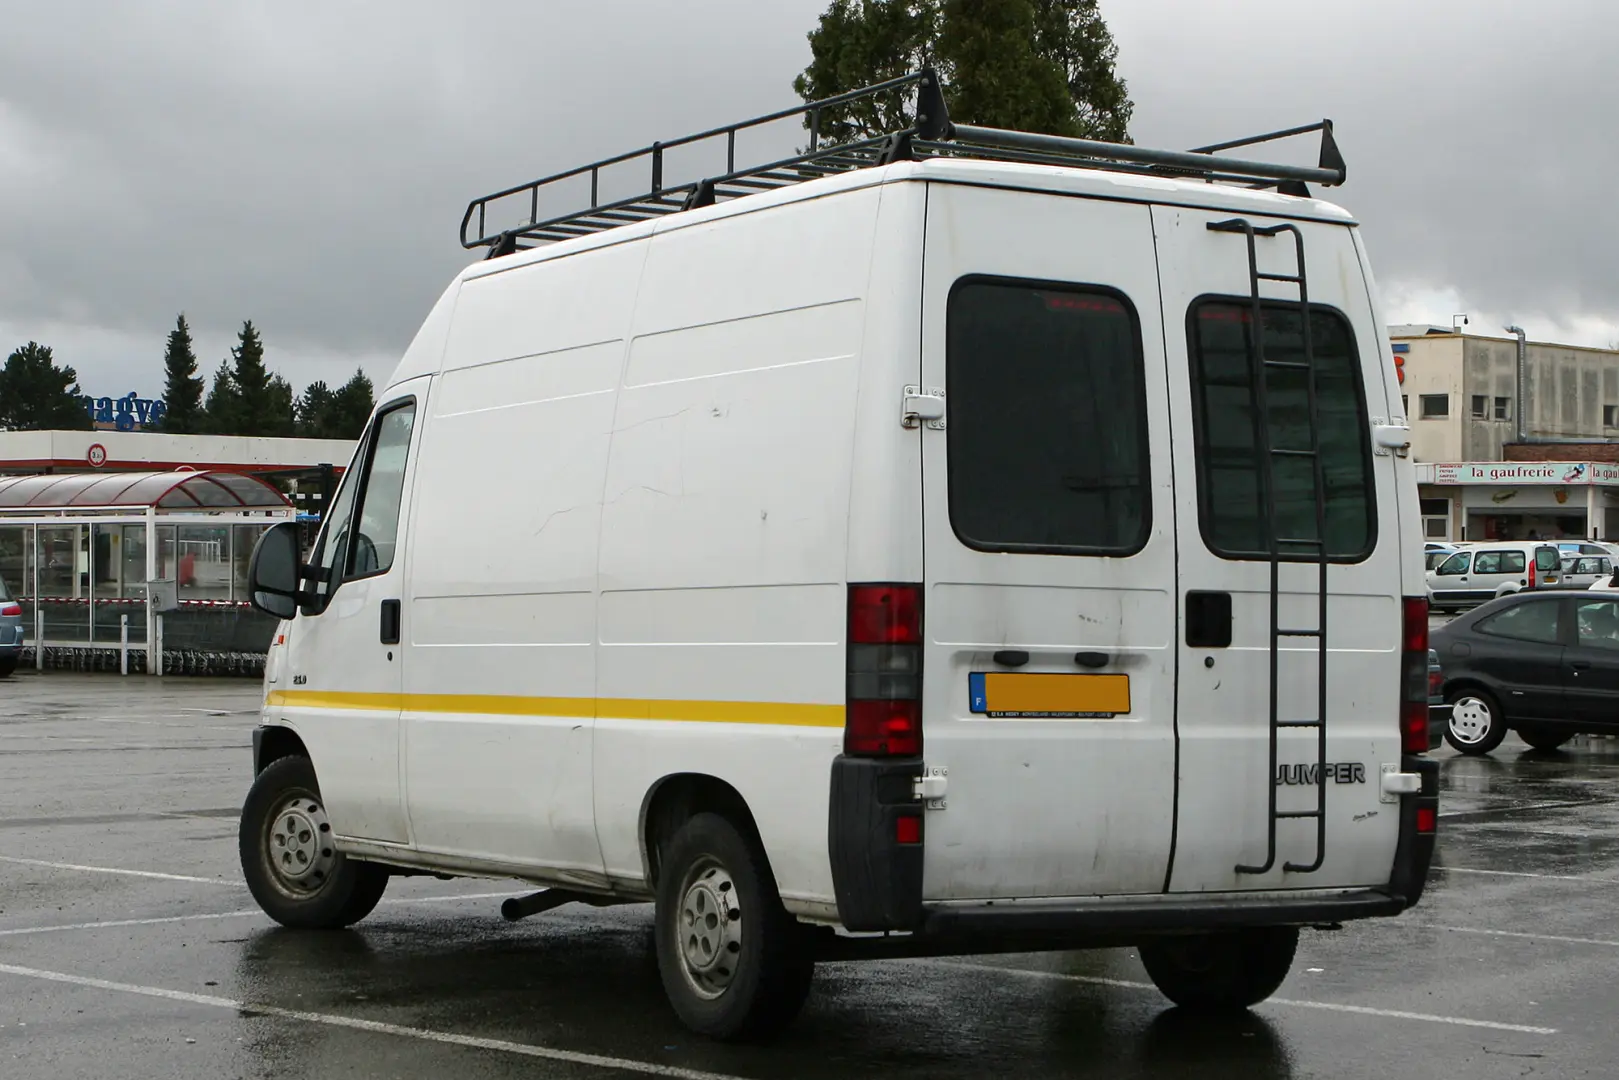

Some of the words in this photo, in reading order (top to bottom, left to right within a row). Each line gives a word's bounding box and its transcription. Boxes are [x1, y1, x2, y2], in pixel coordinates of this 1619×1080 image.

[1472, 467, 1484, 477] la
[1490, 465, 1555, 480] gaufrerie
[1592, 467, 1600, 477] la
[1603, 469, 1619, 480] gau
[975, 697, 982, 706] F
[1275, 763, 1366, 786] JUMPER
